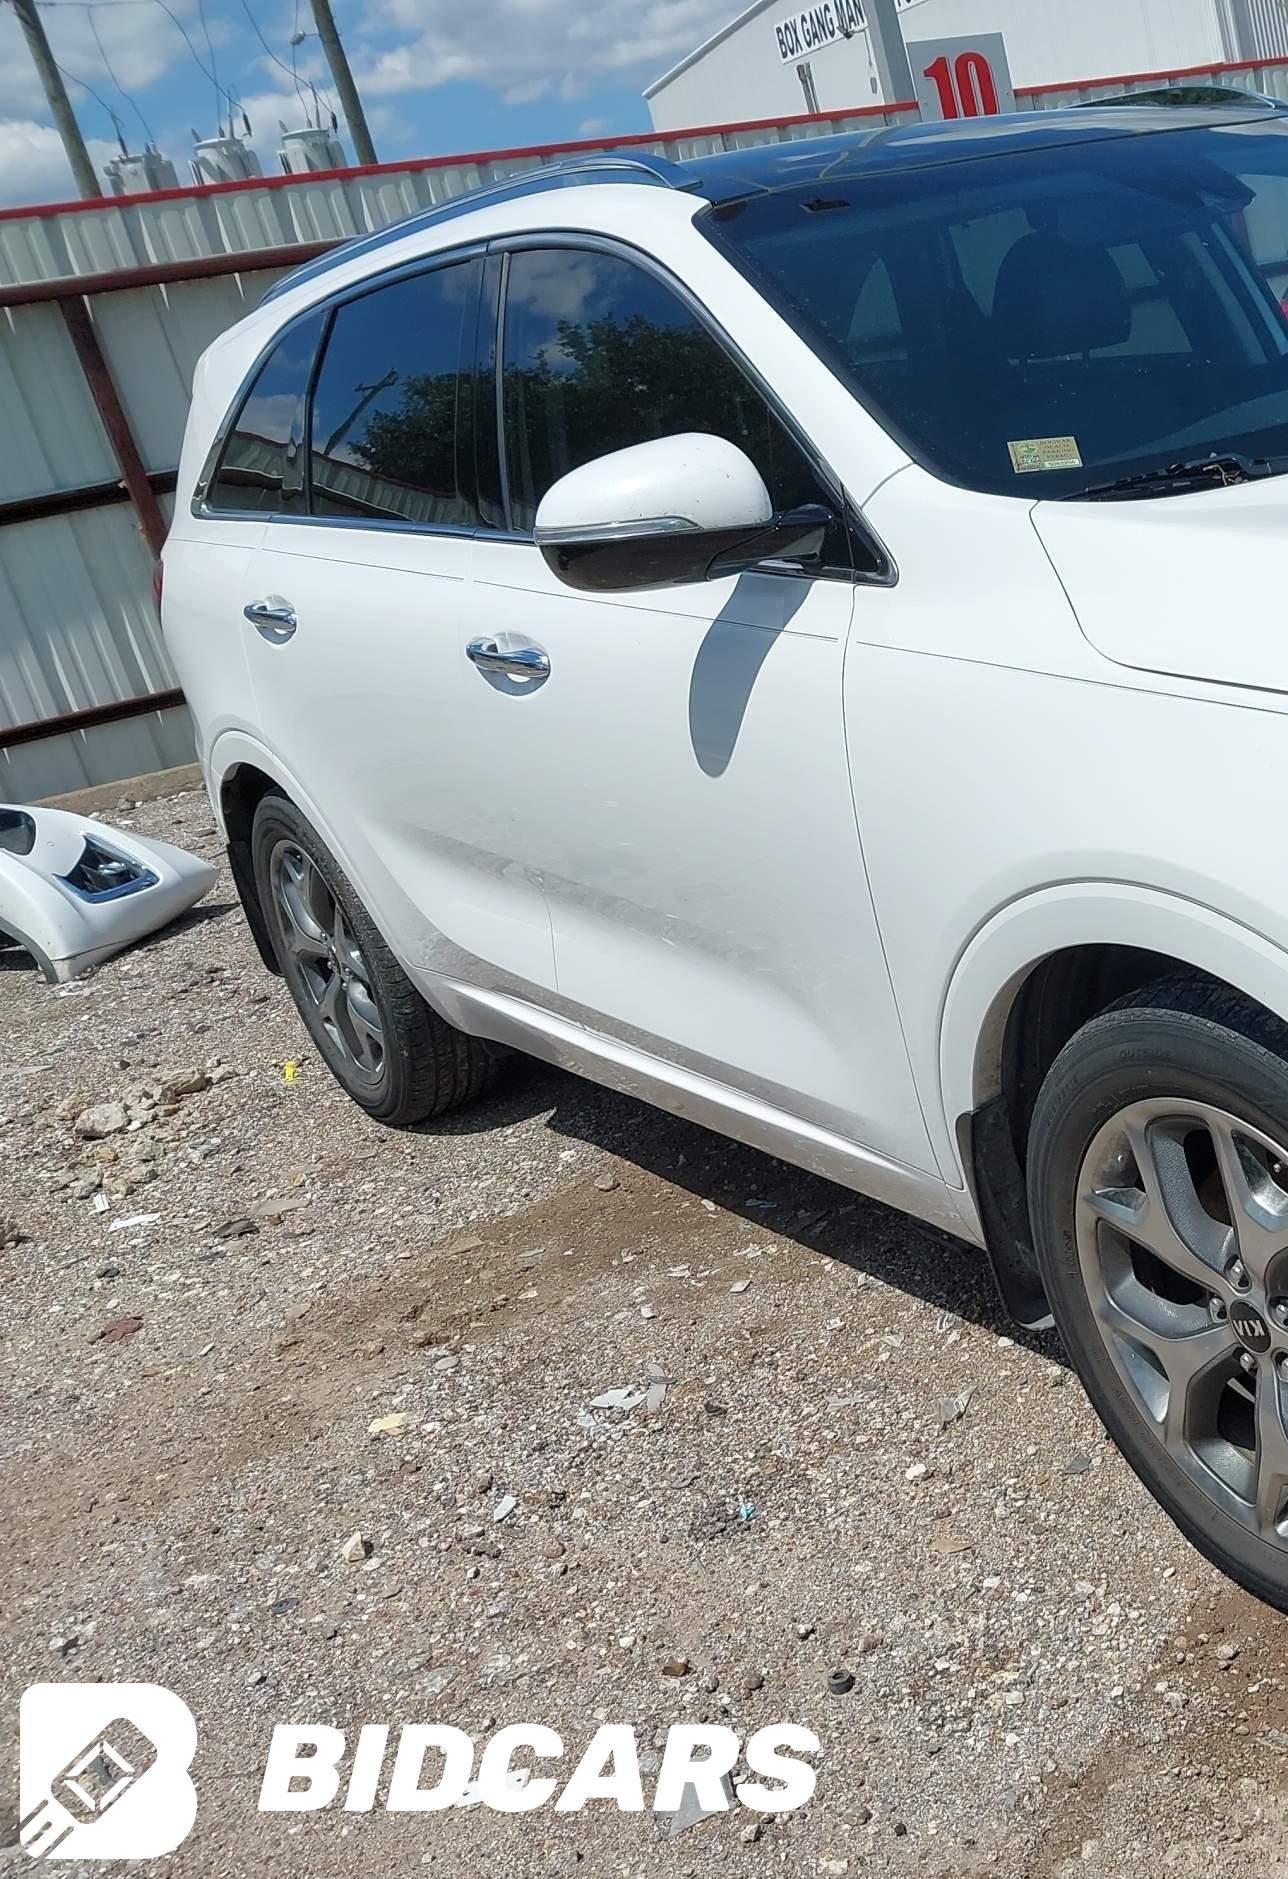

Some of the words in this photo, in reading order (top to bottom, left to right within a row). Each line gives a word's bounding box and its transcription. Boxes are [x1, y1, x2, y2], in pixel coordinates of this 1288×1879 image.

[776, 19, 803, 58] BOX
[801, 3, 835, 48] GANG
[922, 52, 999, 119] 10
[1232, 1319, 1265, 1336] KIA
